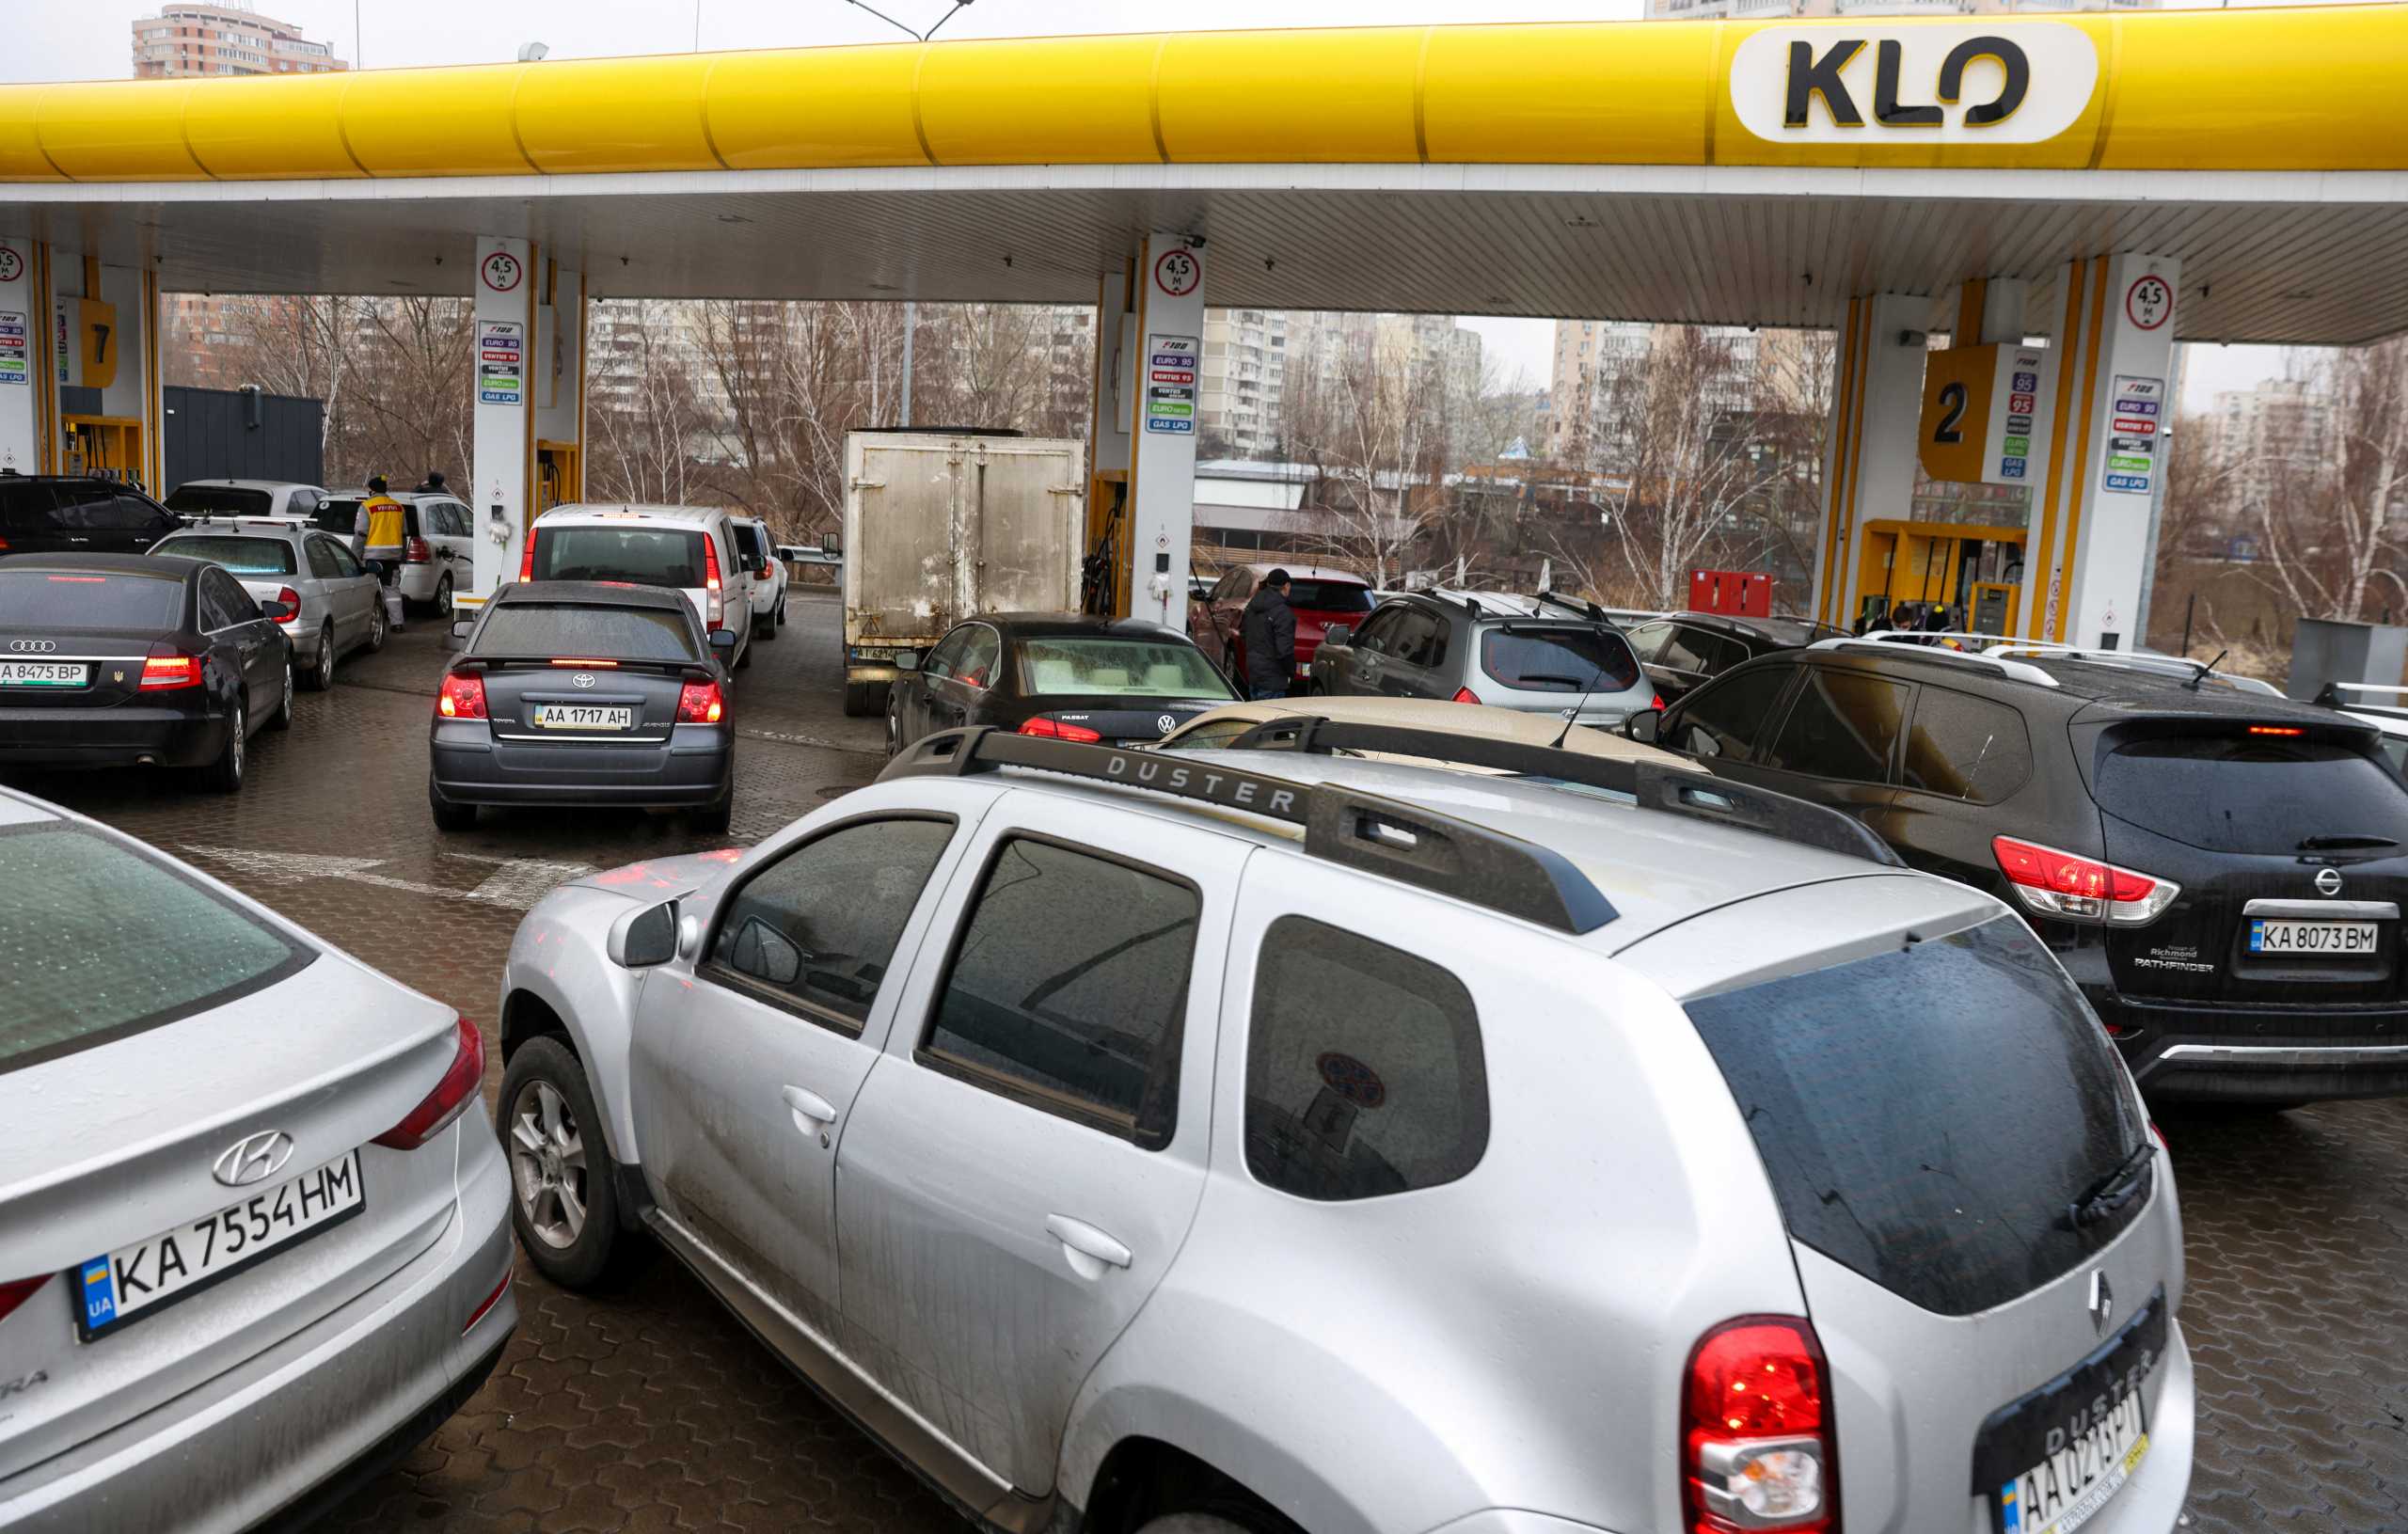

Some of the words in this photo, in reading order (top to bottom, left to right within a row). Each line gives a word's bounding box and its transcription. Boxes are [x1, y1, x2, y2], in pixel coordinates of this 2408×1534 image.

[1783, 35, 2031, 129] KLO
[90, 324, 111, 364] 7
[2017, 378, 2033, 391] 95
[1152, 404, 1174, 413] EURO
[1934, 381, 1968, 444] 2
[2013, 400, 2032, 413] 95
[2118, 402, 2142, 411] EURO
[1172, 421, 1188, 430] LPG
[2110, 477, 2128, 486] GAS
[2129, 479, 2146, 488] LPG
[17, 665, 54, 679] 8475
[58, 666, 82, 679] BP
[546, 708, 564, 722] AA
[571, 709, 603, 722] 1717
[608, 710, 628, 723] AH
[1107, 756, 1295, 813] DUSTER
[2263, 926, 2291, 948] KA
[2296, 927, 2342, 949] 8073
[2346, 928, 2374, 949] BM
[2150, 947, 2197, 958] Richmond
[2134, 957, 2214, 973] PATHFINDER
[115, 1246, 188, 1305] KA
[194, 1185, 295, 1268] 7554
[299, 1157, 353, 1221] HM
[88, 1296, 112, 1317] UA
[2024, 1456, 2063, 1532] AA
